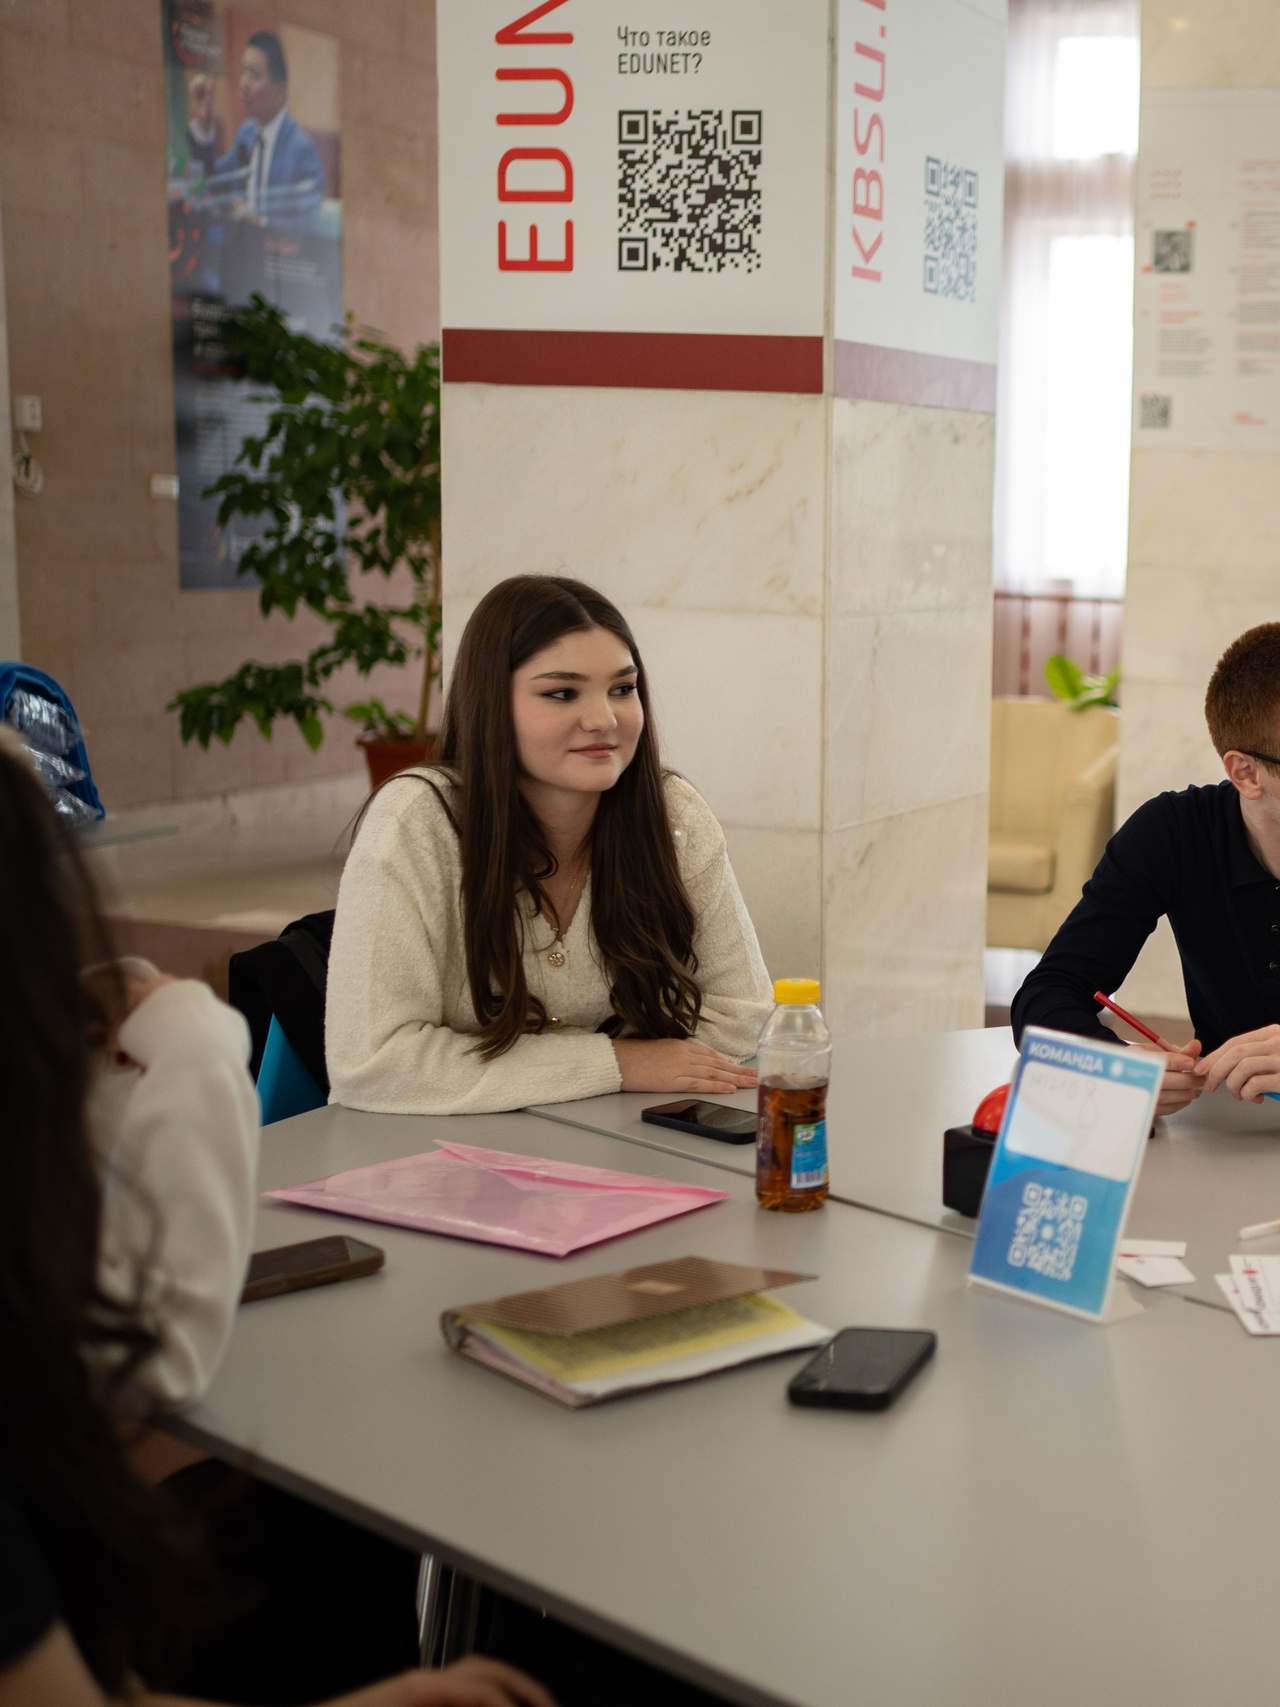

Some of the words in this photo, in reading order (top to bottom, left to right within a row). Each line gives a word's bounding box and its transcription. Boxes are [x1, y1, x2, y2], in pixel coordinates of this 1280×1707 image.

[617, 25, 650, 46] Что
[657, 29, 712, 46] такое
[617, 52, 703, 75] EDUNET?
[850, 0, 888, 282] KBSU.
[1027, 1040, 1105, 1074] КОМАНДА
